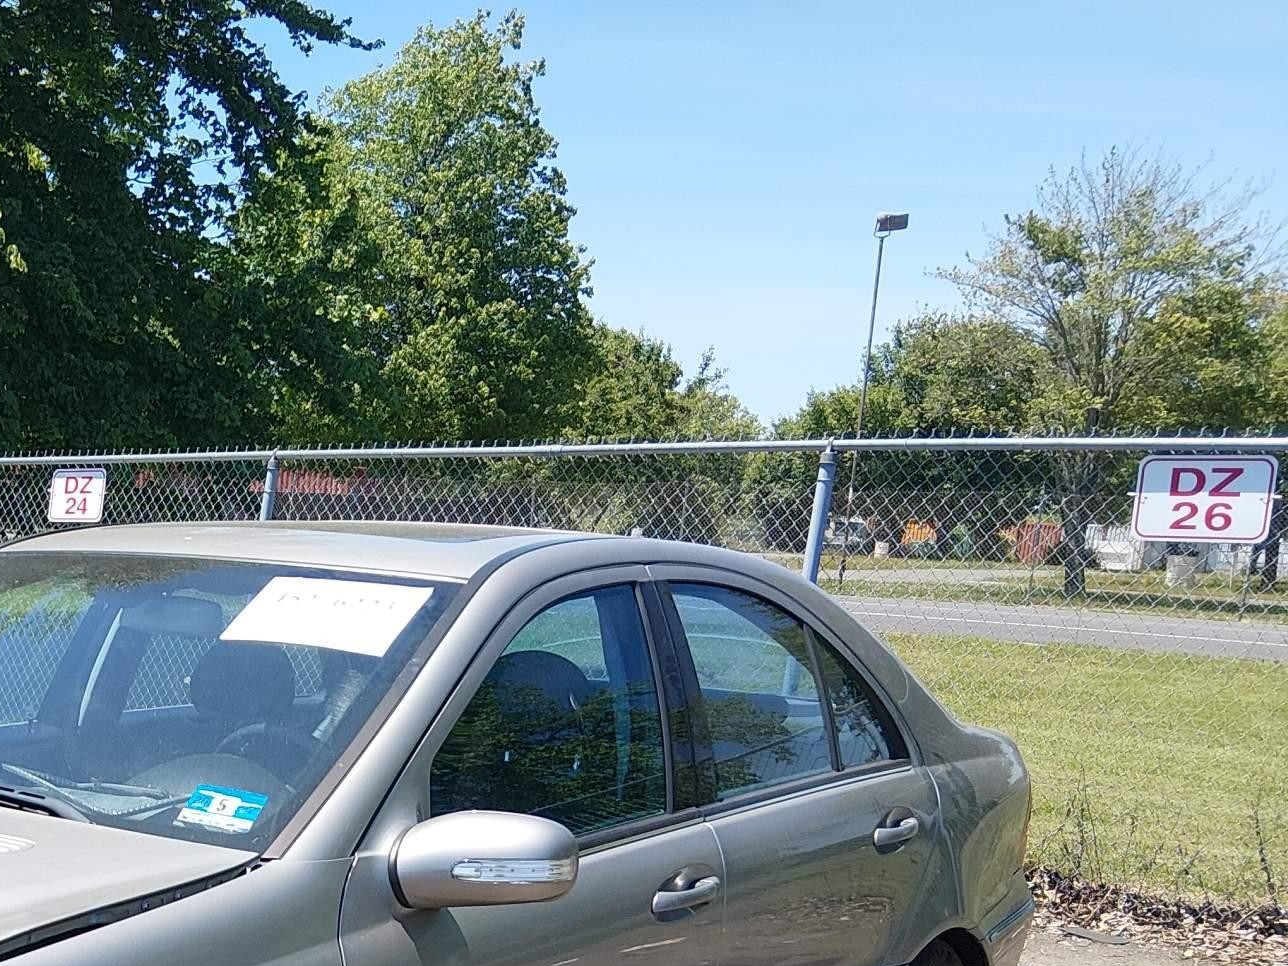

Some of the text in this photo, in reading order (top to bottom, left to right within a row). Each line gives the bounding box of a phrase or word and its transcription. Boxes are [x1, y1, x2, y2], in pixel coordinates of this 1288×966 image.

[64, 476, 94, 494] DZ
[1169, 467, 1245, 497] DZ
[65, 497, 88, 515] 24
[1168, 501, 1233, 532] 26
[216, 798, 230, 812] 5
